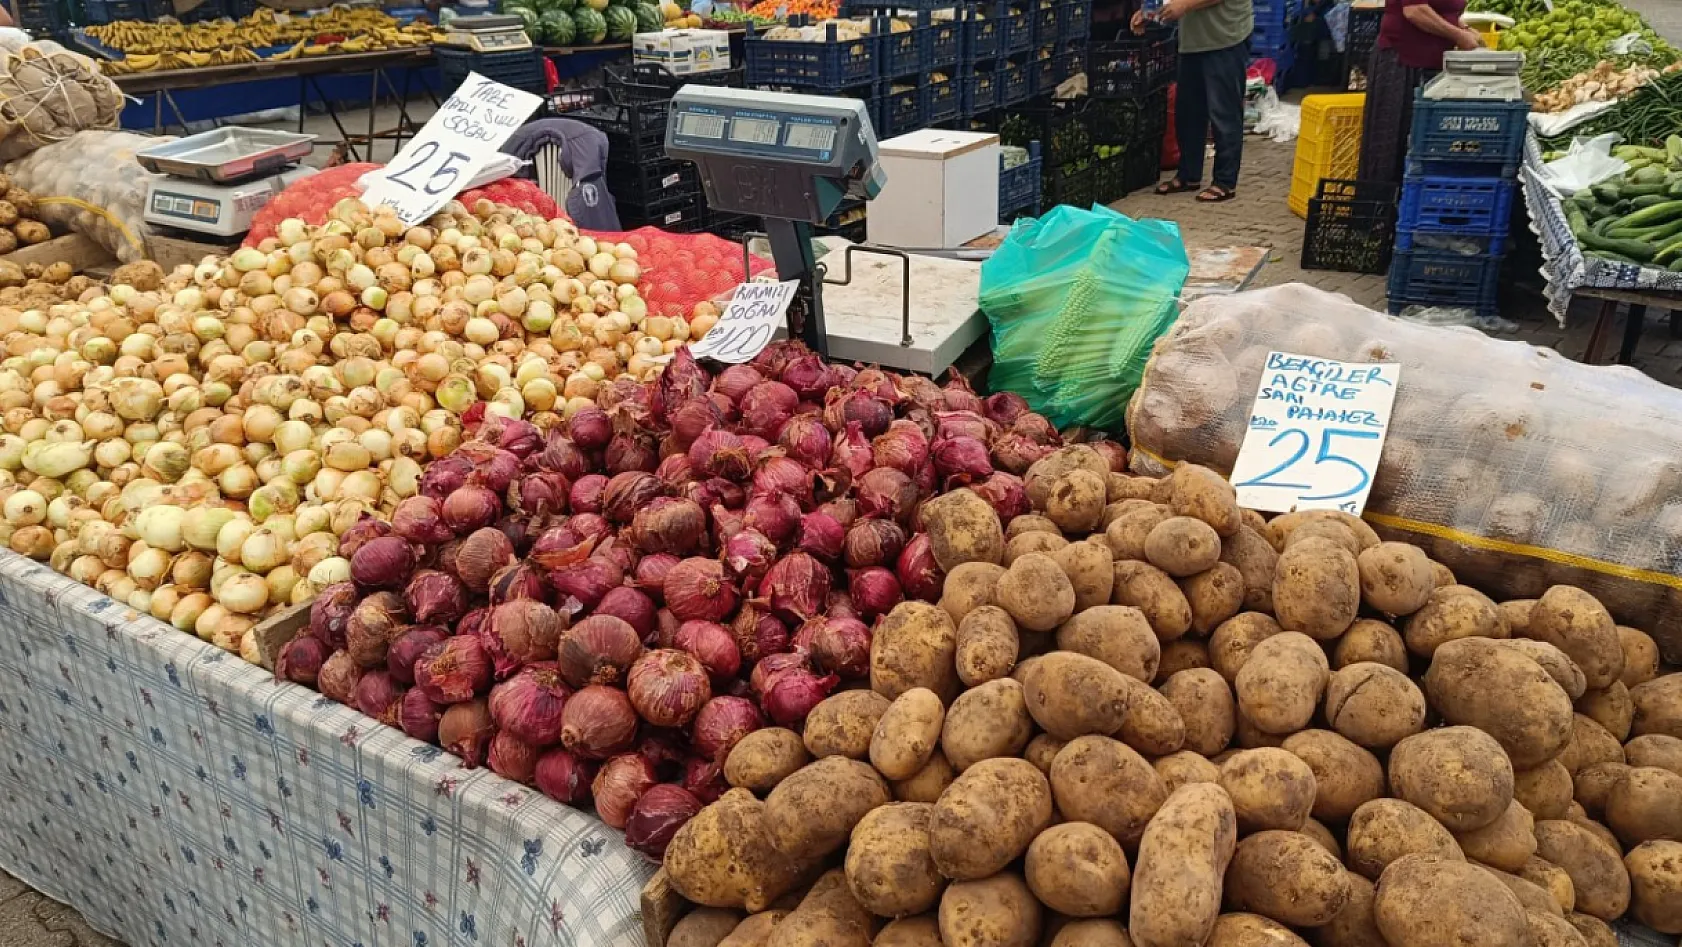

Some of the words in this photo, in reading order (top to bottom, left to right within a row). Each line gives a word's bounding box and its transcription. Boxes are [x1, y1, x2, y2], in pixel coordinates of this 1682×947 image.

[470, 80, 515, 109] TAZE
[385, 140, 471, 195] 25
[721, 300, 781, 321] SOĞAN
[1258, 387, 1304, 405] SARI
[1235, 427, 1380, 501] 25
